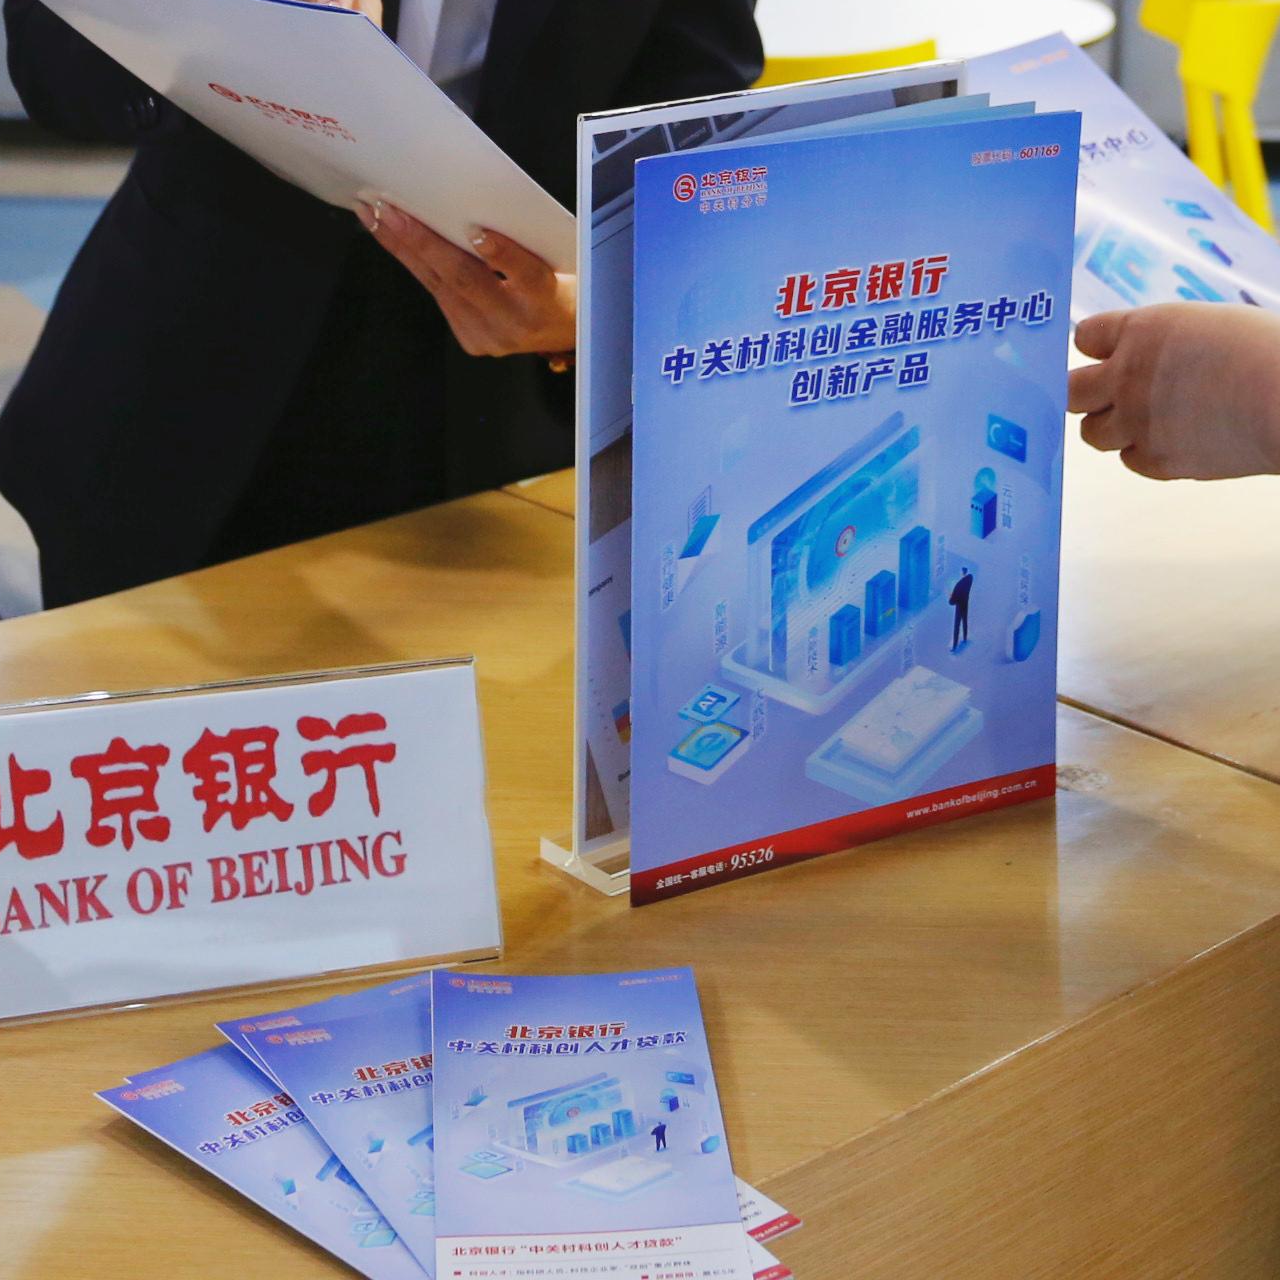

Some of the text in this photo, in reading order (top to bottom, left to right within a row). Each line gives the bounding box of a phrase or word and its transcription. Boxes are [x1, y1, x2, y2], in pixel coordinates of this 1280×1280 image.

[701, 166, 768, 188] 北京银行
[776, 255, 949, 317] 北京银行
[662, 292, 1053, 383] 中关村科创金融服务中心
[790, 351, 930, 406] 创新产品
[906, 779, 1037, 819] www.bankofbeijing.com.cn
[126, 862, 193, 915] OF
[207, 830, 408, 903] BEIJING
[448, 1031, 688, 1055] 中关村科创人才贷款
[505, 1022, 628, 1040] 北京银行
